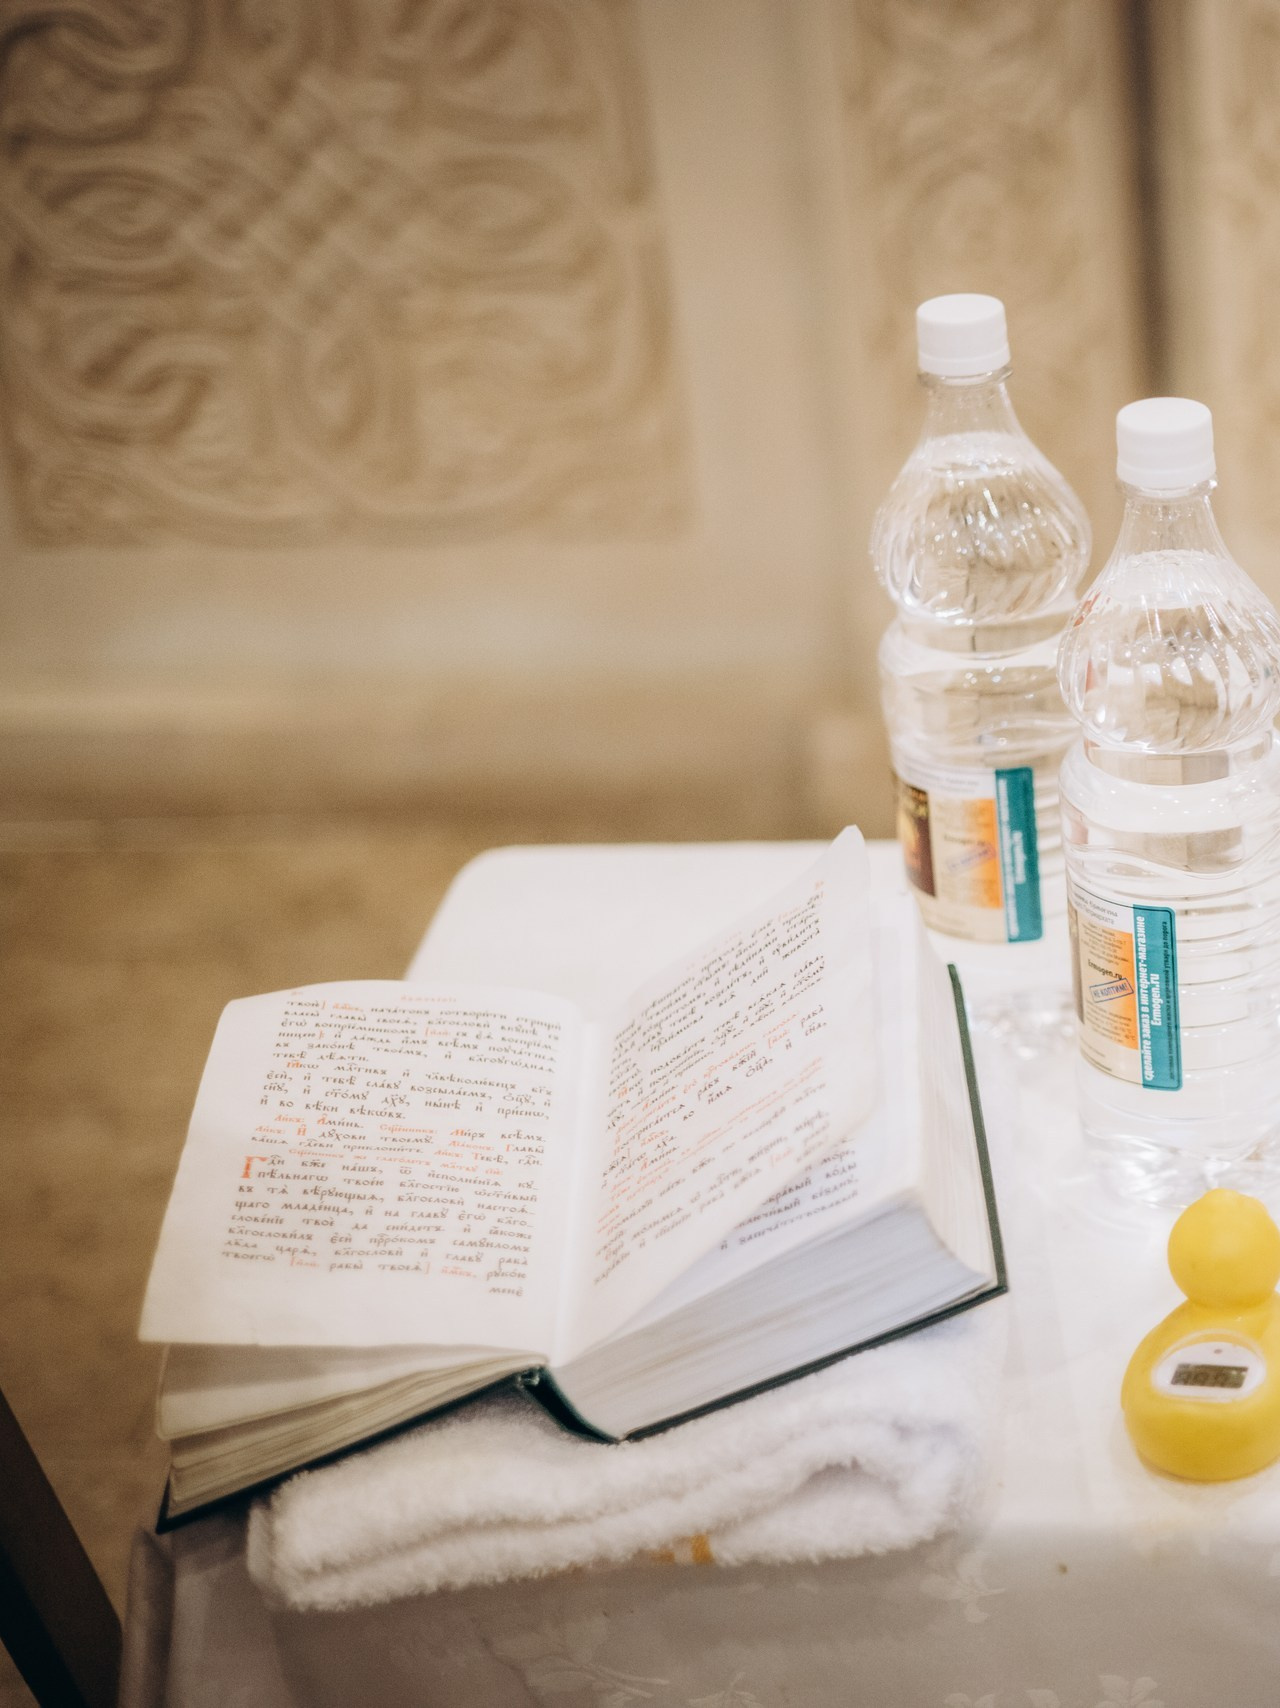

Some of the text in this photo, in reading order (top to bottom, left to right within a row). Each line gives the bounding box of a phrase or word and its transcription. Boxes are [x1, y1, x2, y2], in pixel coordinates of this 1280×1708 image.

[1161, 921, 1169, 941] порога
[1088, 959, 1123, 980] Ermogen.ru
[1136, 916, 1150, 1005] интернет-магазине
[1093, 983, 1127, 999] НЕ КОПТИМ!
[1150, 973, 1163, 1026] Ermogen.ru
[1141, 1014, 1151, 1039] заказ
[1141, 1040, 1154, 1081] сделайте
